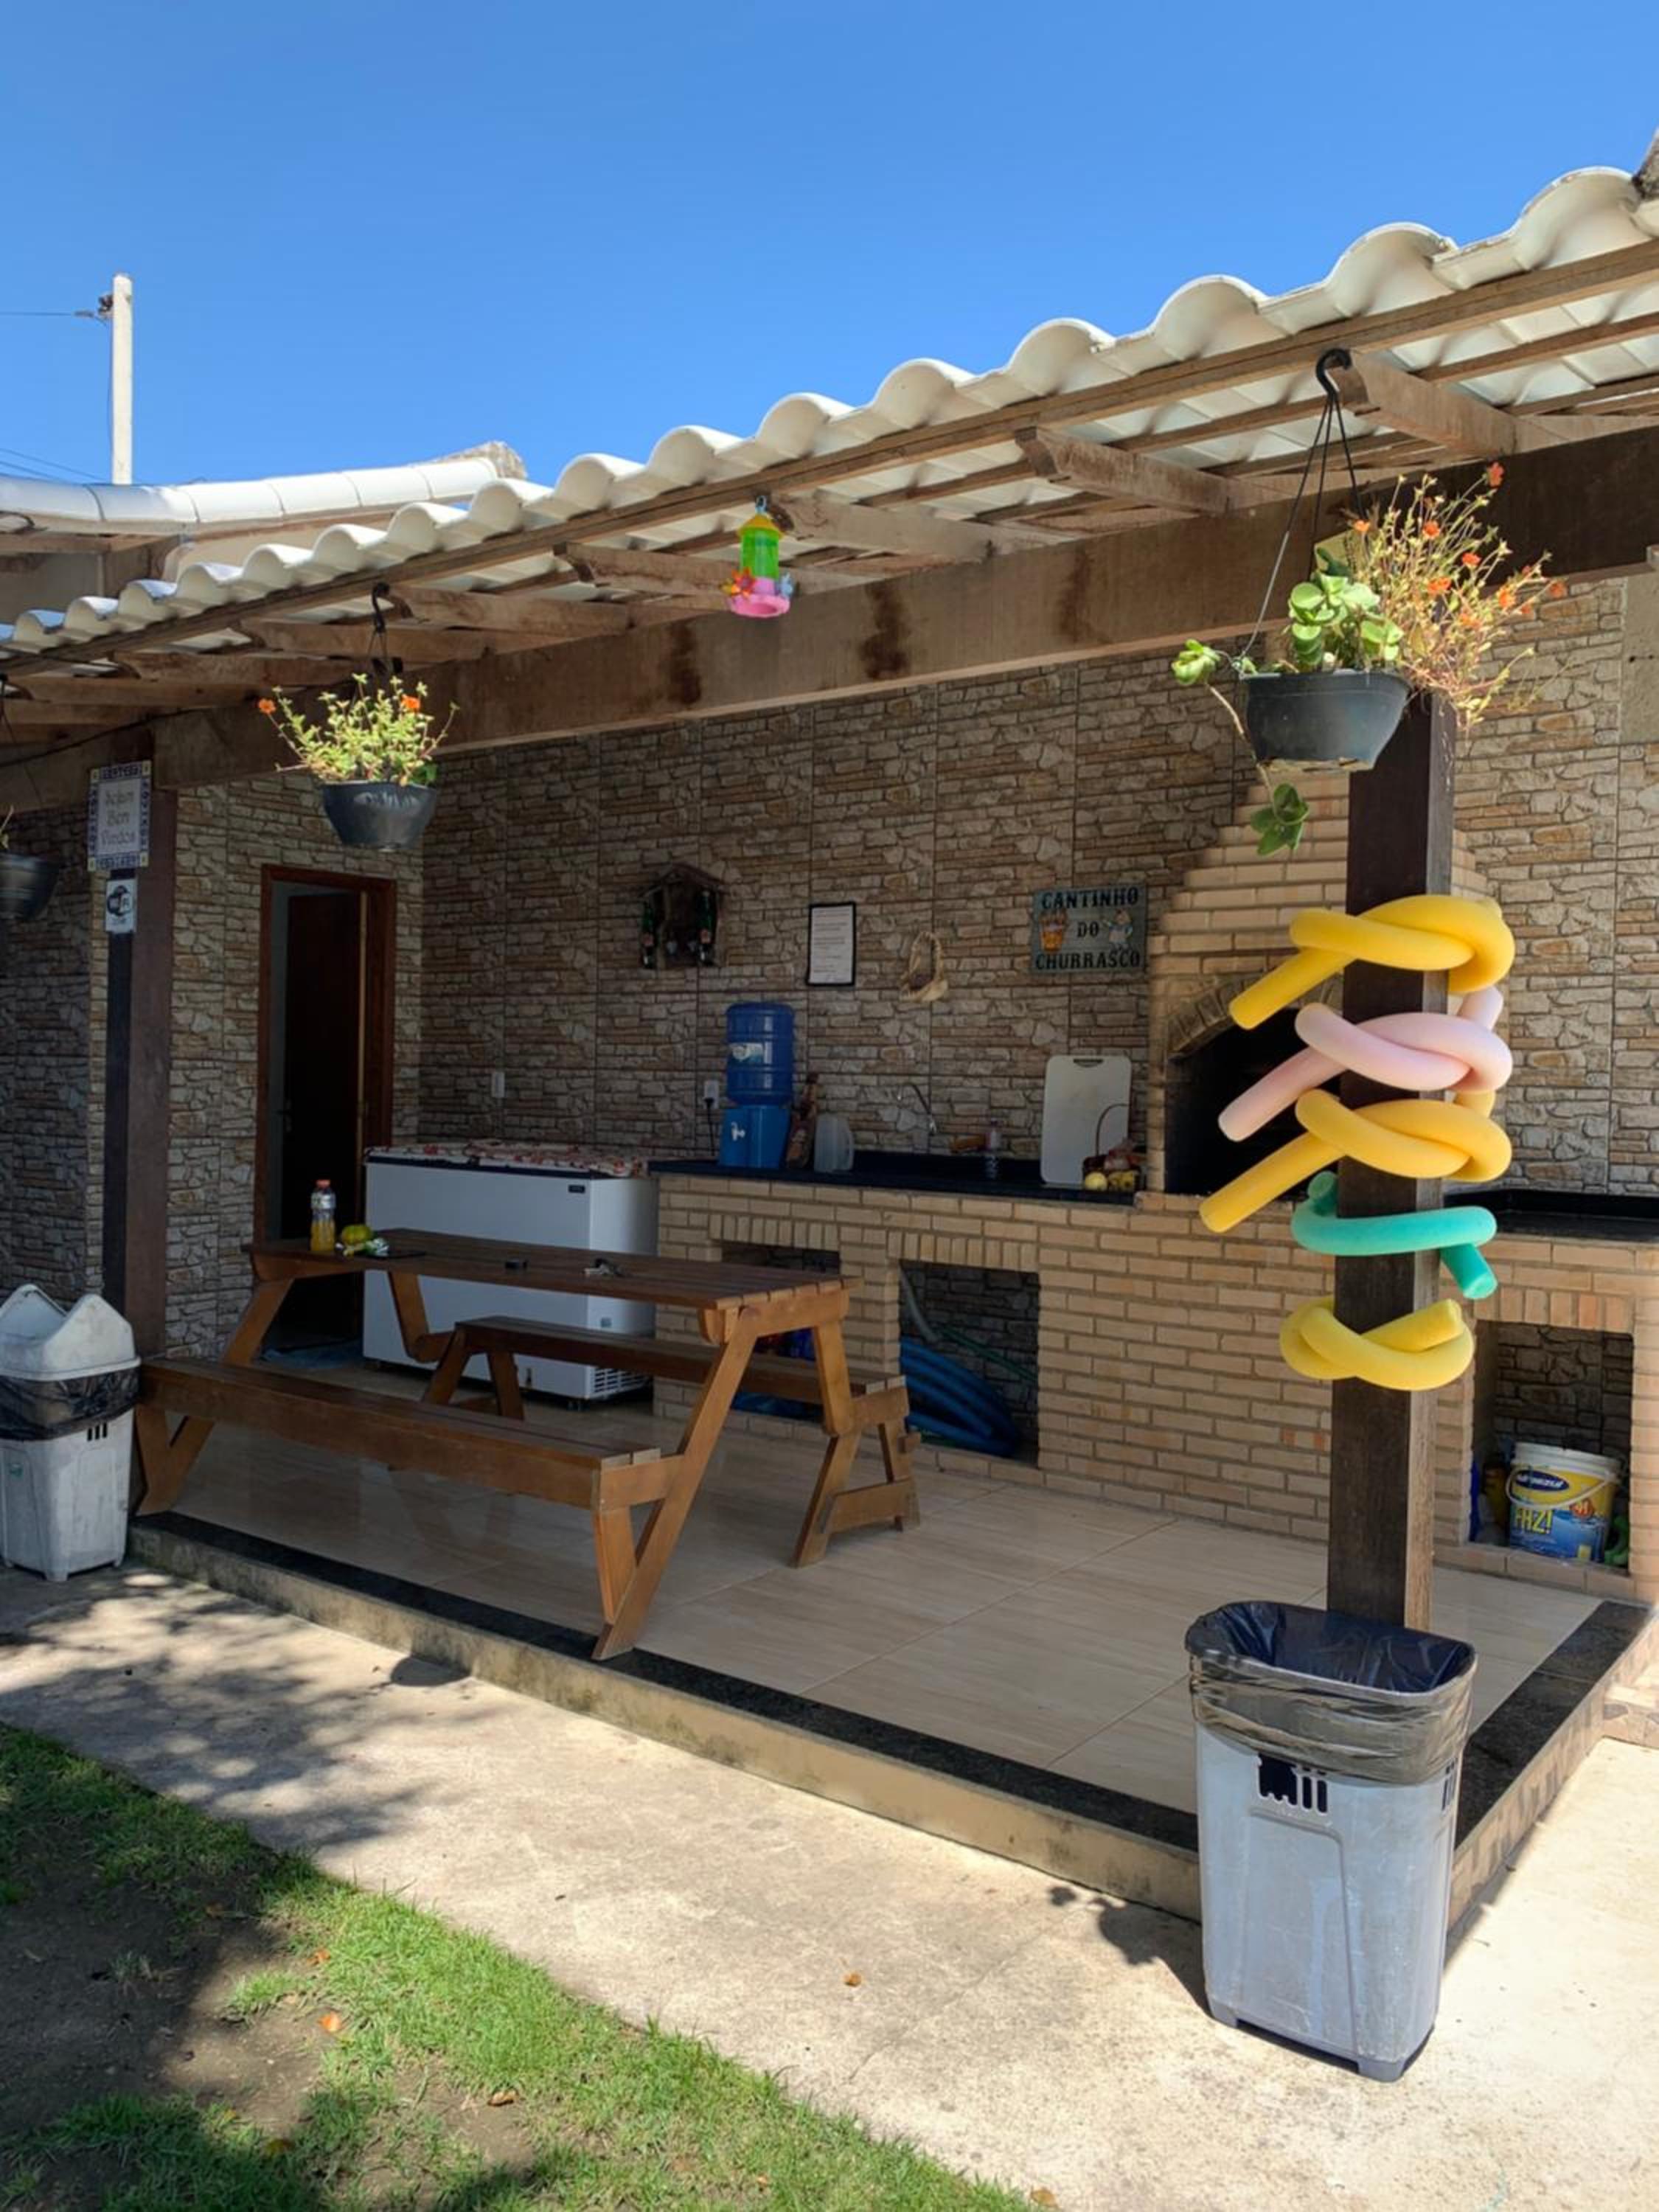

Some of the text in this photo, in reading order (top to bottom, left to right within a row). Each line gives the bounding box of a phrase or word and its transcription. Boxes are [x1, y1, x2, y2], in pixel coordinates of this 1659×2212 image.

[1042, 887, 1138, 908] CANTINHO
[1077, 922, 1099, 937] DO
[1036, 950, 1140, 970] CHURRASCO
